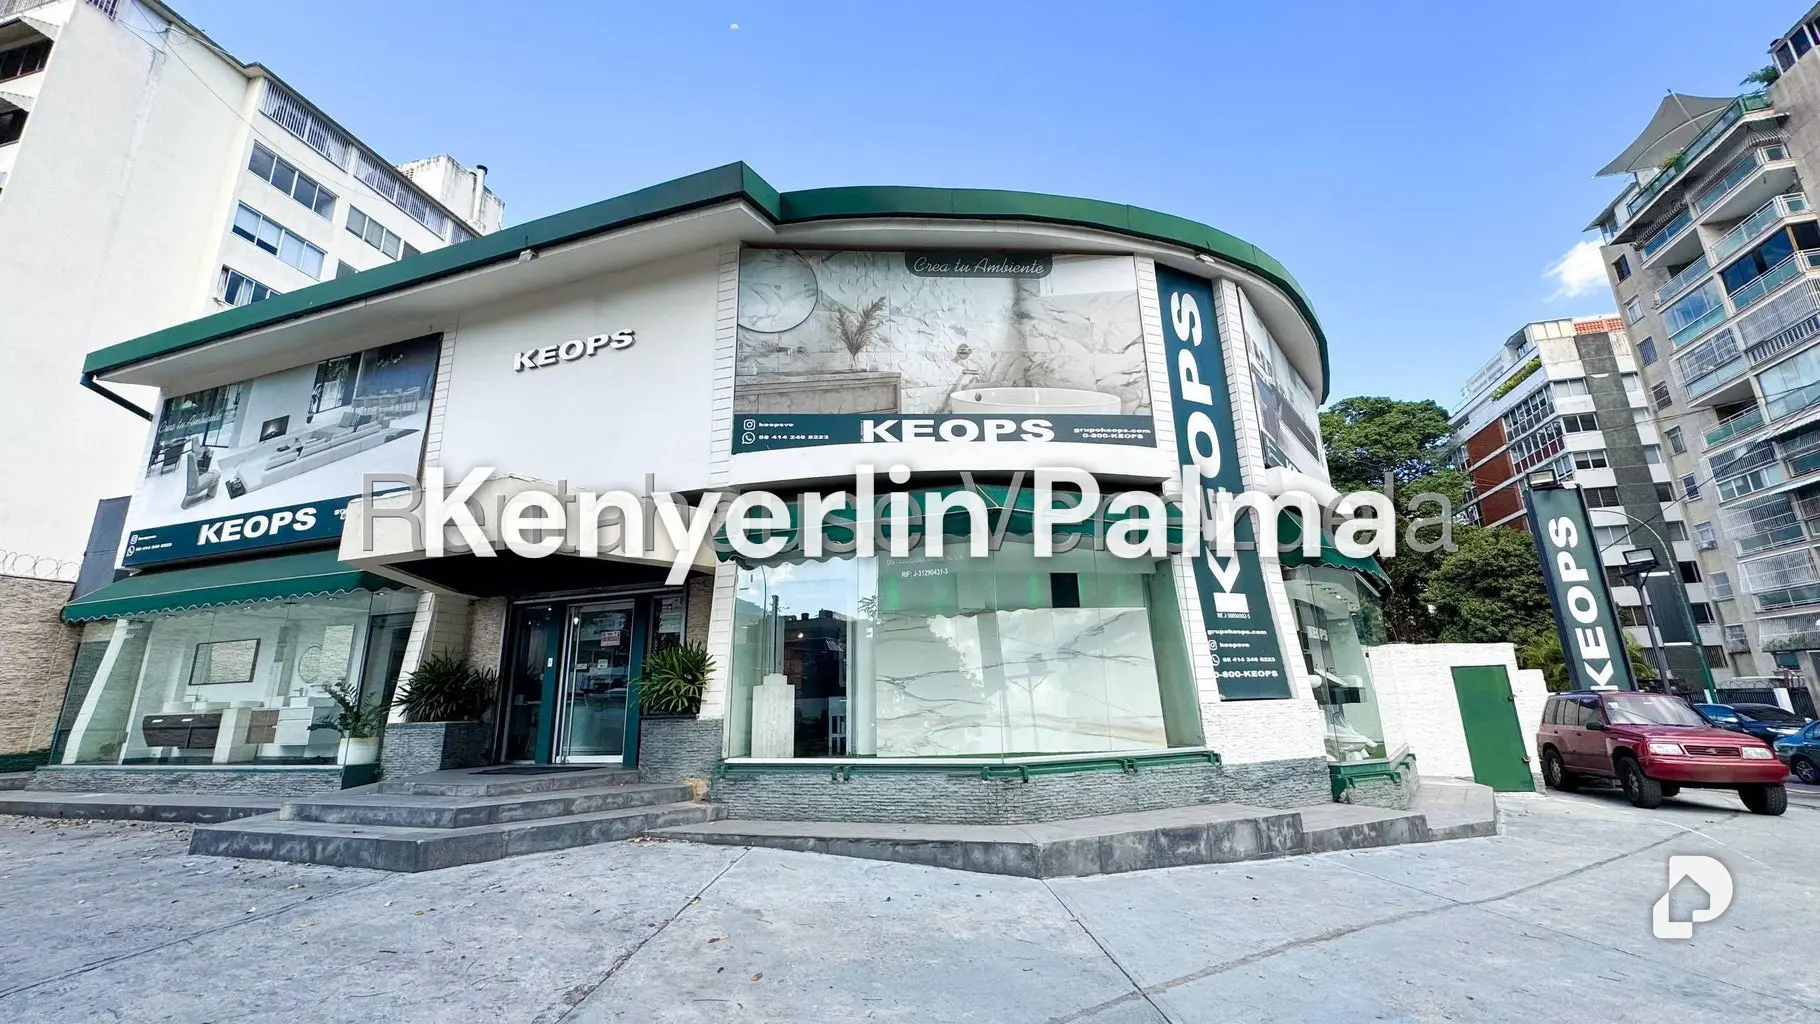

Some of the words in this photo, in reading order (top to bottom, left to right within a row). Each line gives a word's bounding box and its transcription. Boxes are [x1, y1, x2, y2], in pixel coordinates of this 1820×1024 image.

[913, 256, 950, 273] Crea
[954, 257, 971, 273] tu
[973, 256, 1044, 274] Ambiente
[513, 328, 635, 372] KEOPS
[862, 419, 1055, 443] KEOPS
[1170, 291, 1250, 613] KEOPS
[197, 507, 317, 546] KEOPS
[1548, 515, 1619, 690] KEOPS
